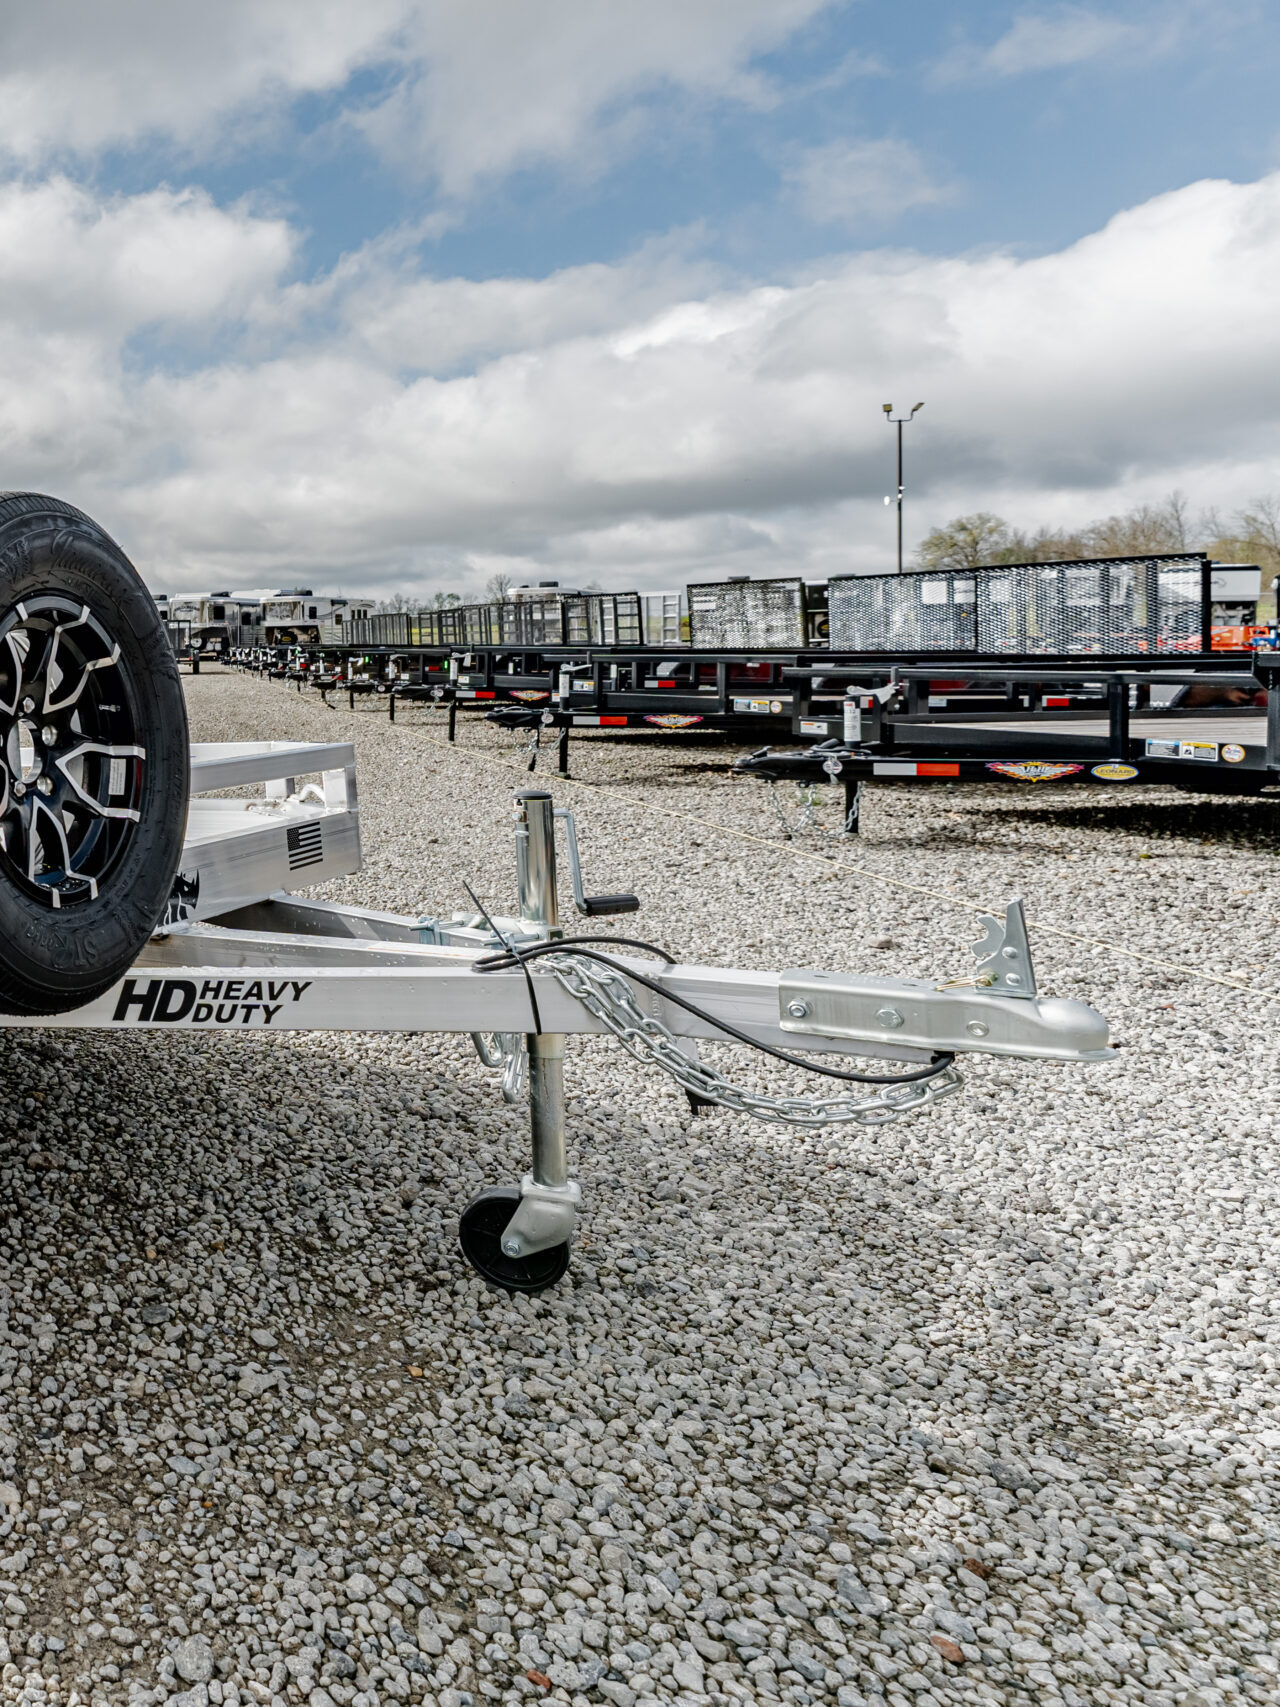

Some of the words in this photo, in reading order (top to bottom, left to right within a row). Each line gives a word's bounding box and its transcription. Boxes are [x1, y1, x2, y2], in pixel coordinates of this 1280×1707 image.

[112, 979, 197, 1022] HD
[199, 980, 312, 1002] HEAVY
[191, 1003, 283, 1024] DUTY
